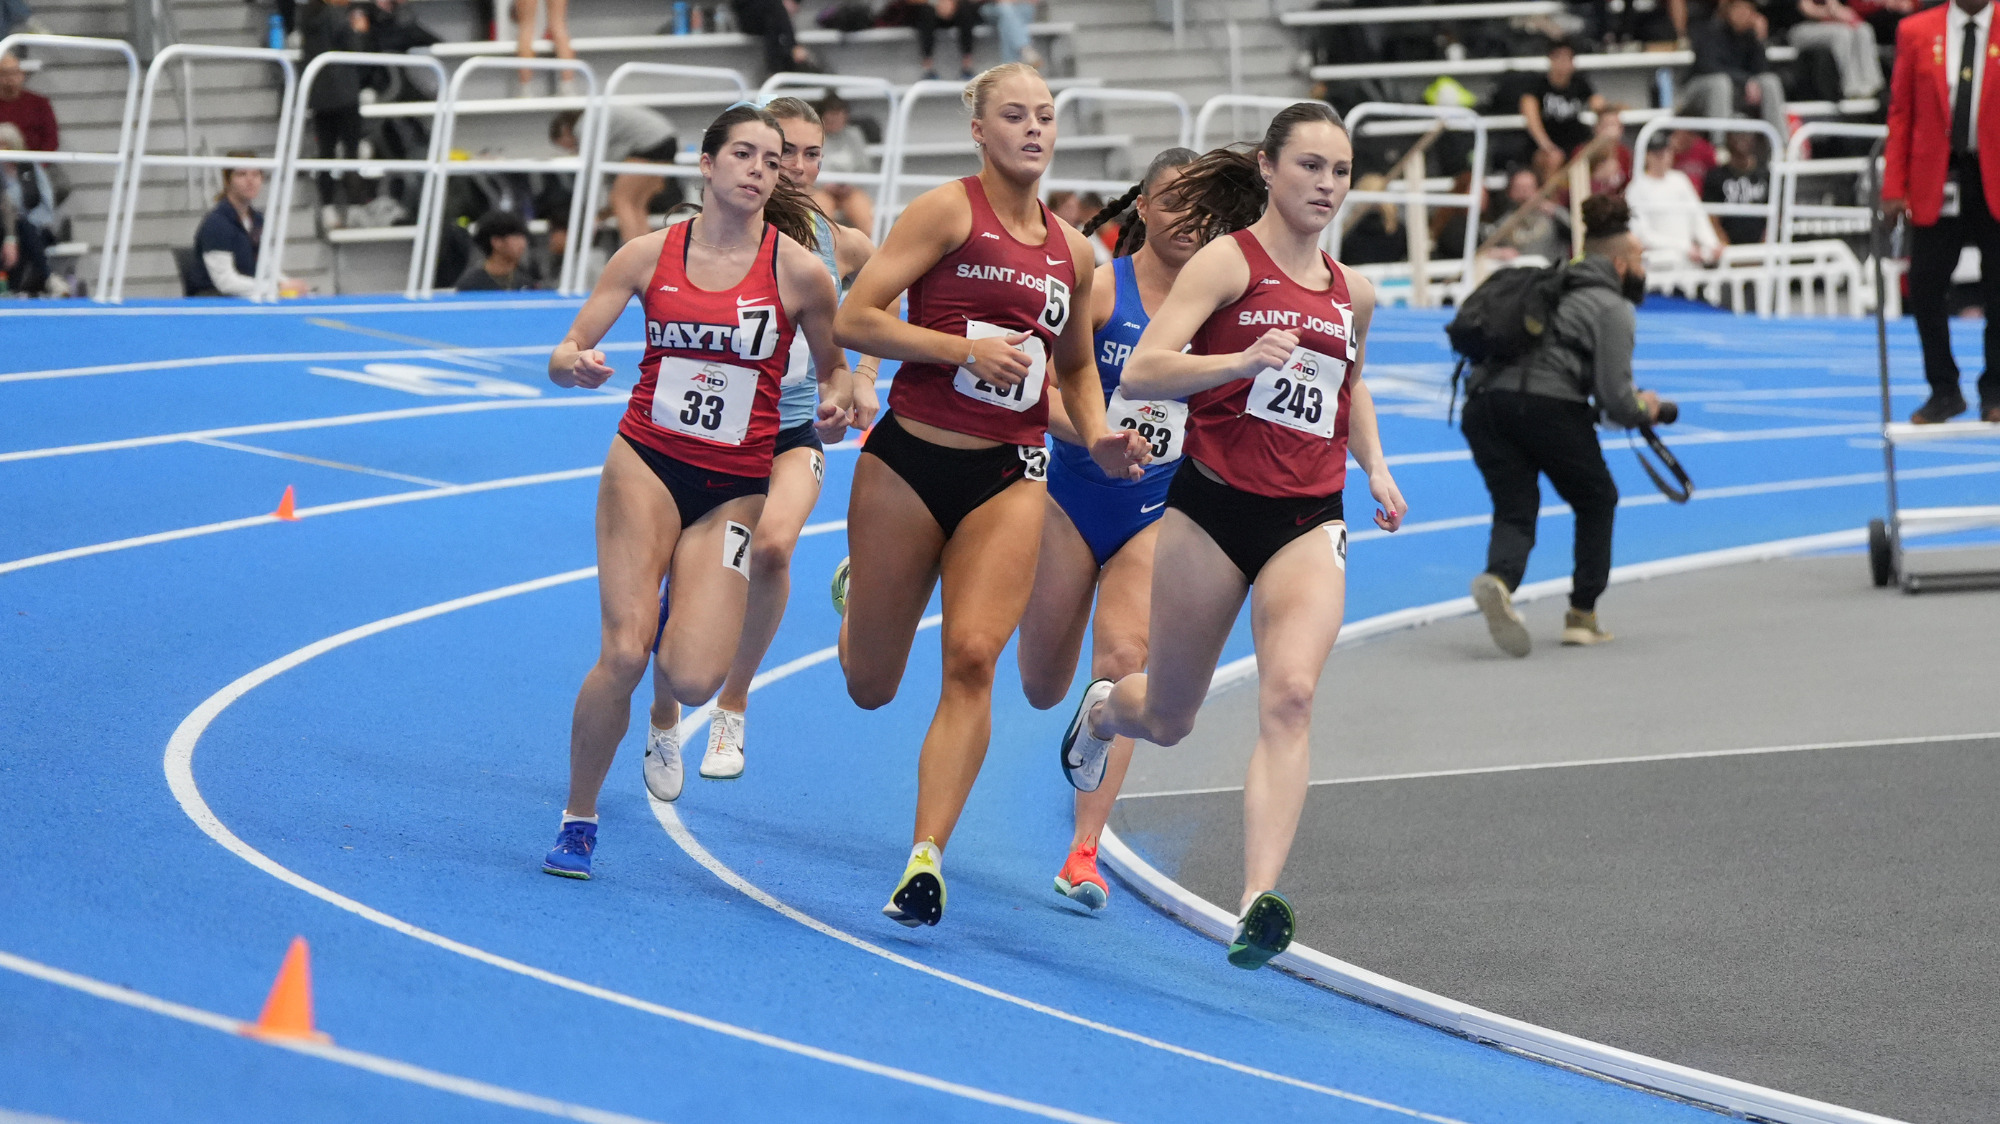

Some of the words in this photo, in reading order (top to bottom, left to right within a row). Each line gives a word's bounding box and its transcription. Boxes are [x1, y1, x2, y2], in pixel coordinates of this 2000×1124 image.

[956, 263, 1016, 283] SAINT
[1016, 271, 1046, 294] JOS
[1045, 280, 1065, 327] 5
[742, 310, 770, 356] 7
[1238, 310, 1301, 327] SAINT
[1302, 315, 1347, 341] JOSE
[1101, 341, 1137, 367] SA
[1290, 362, 1316, 376] A10
[691, 373, 724, 387] A10
[680, 391, 725, 431] 33
[1137, 405, 1165, 418] A10
[1267, 378, 1323, 424] 243
[730, 525, 750, 568] 7
